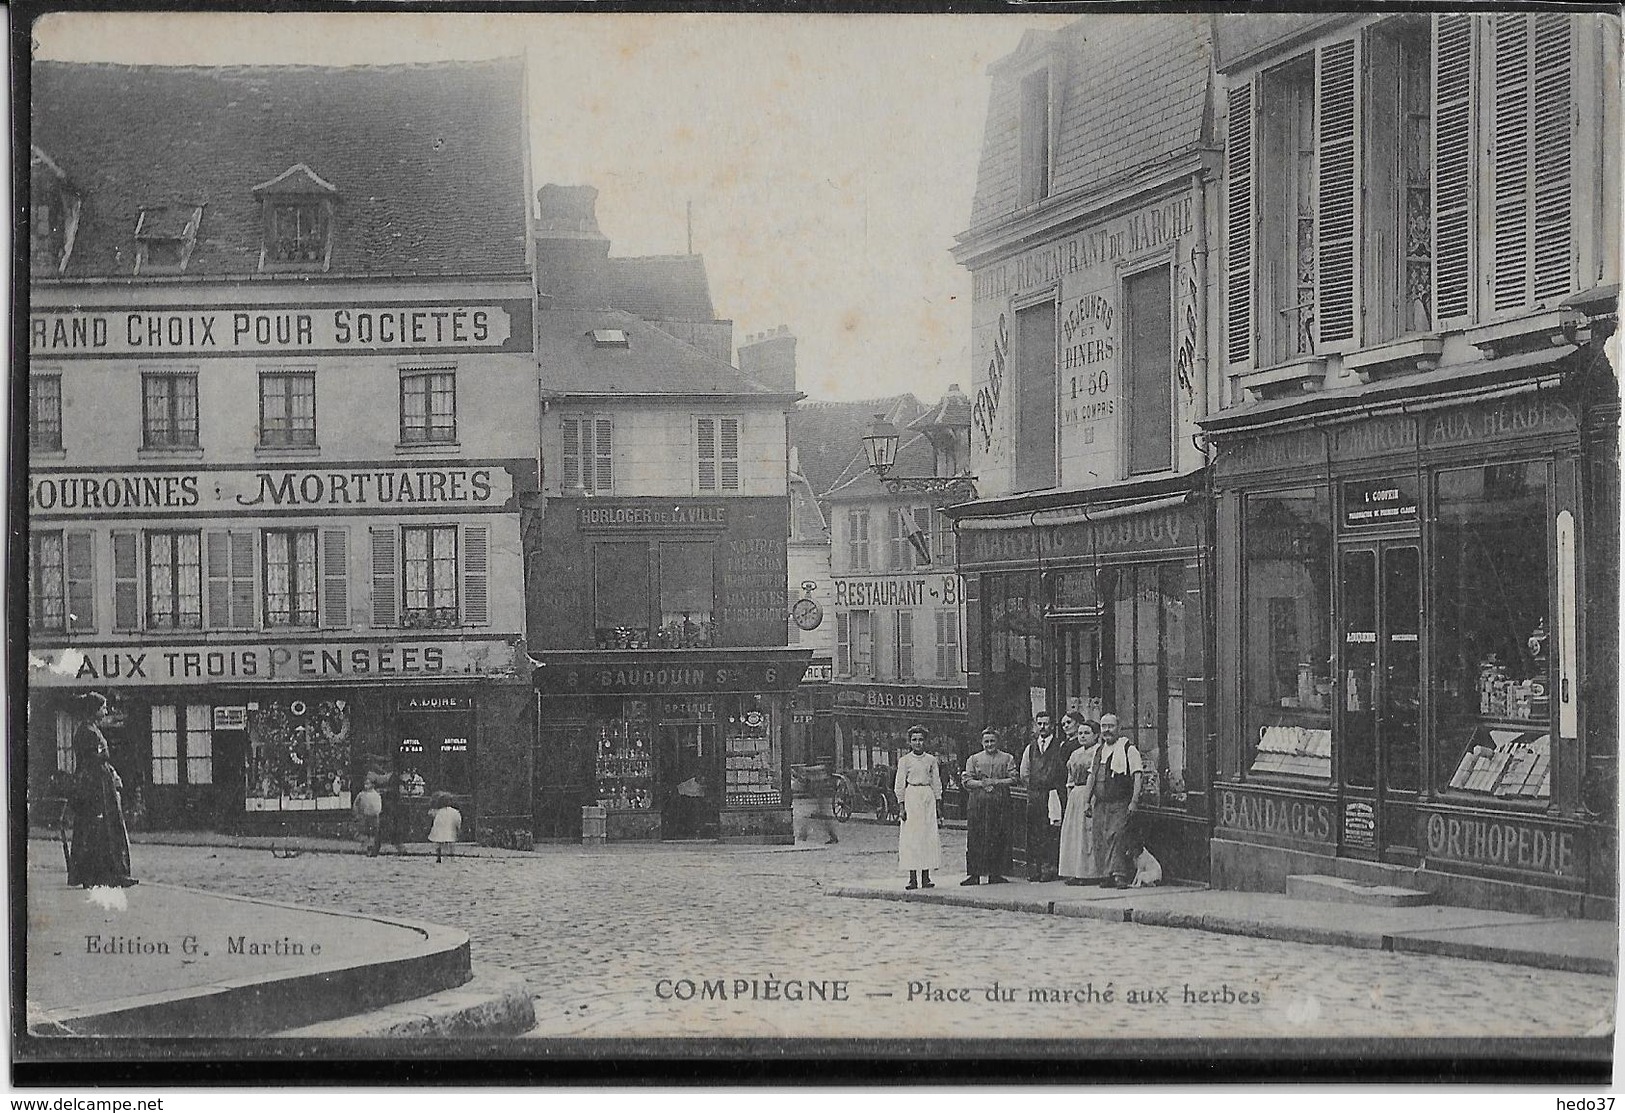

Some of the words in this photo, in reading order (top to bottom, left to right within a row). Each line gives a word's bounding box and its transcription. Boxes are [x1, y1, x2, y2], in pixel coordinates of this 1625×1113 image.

[1016, 230, 1108, 291] RESTAURANT
[1110, 232, 1124, 260] DU
[127, 314, 216, 347] CHOIX
[233, 312, 313, 346] POUR
[334, 308, 489, 344] SOCIETÉS
[1064, 294, 1114, 342] DEJEUNERS
[1080, 325, 1095, 337] ET
[1065, 337, 1114, 369] DINERS
[1065, 406, 1078, 423] VIN
[1082, 400, 1114, 420] COMPRIS
[1433, 411, 1473, 442] AUX
[1483, 400, 1578, 438] HERBES
[236, 471, 492, 507] MORTUAIRES
[581, 508, 650, 525] HORLOGER
[654, 512, 669, 524] DE
[671, 511, 687, 523] LA
[688, 507, 726, 523] VILLE
[834, 580, 926, 607] RESTAURANT
[75, 653, 147, 680] AUX
[163, 652, 258, 678] TROIS
[267, 644, 444, 680] PENSÉES
[765, 668, 777, 684] 6
[867, 689, 894, 706] BAR
[899, 694, 924, 708] DES
[793, 715, 813, 723] LIP
[1220, 789, 1330, 840] BANDAGES
[1426, 812, 1574, 873] ORTHOPEDIE
